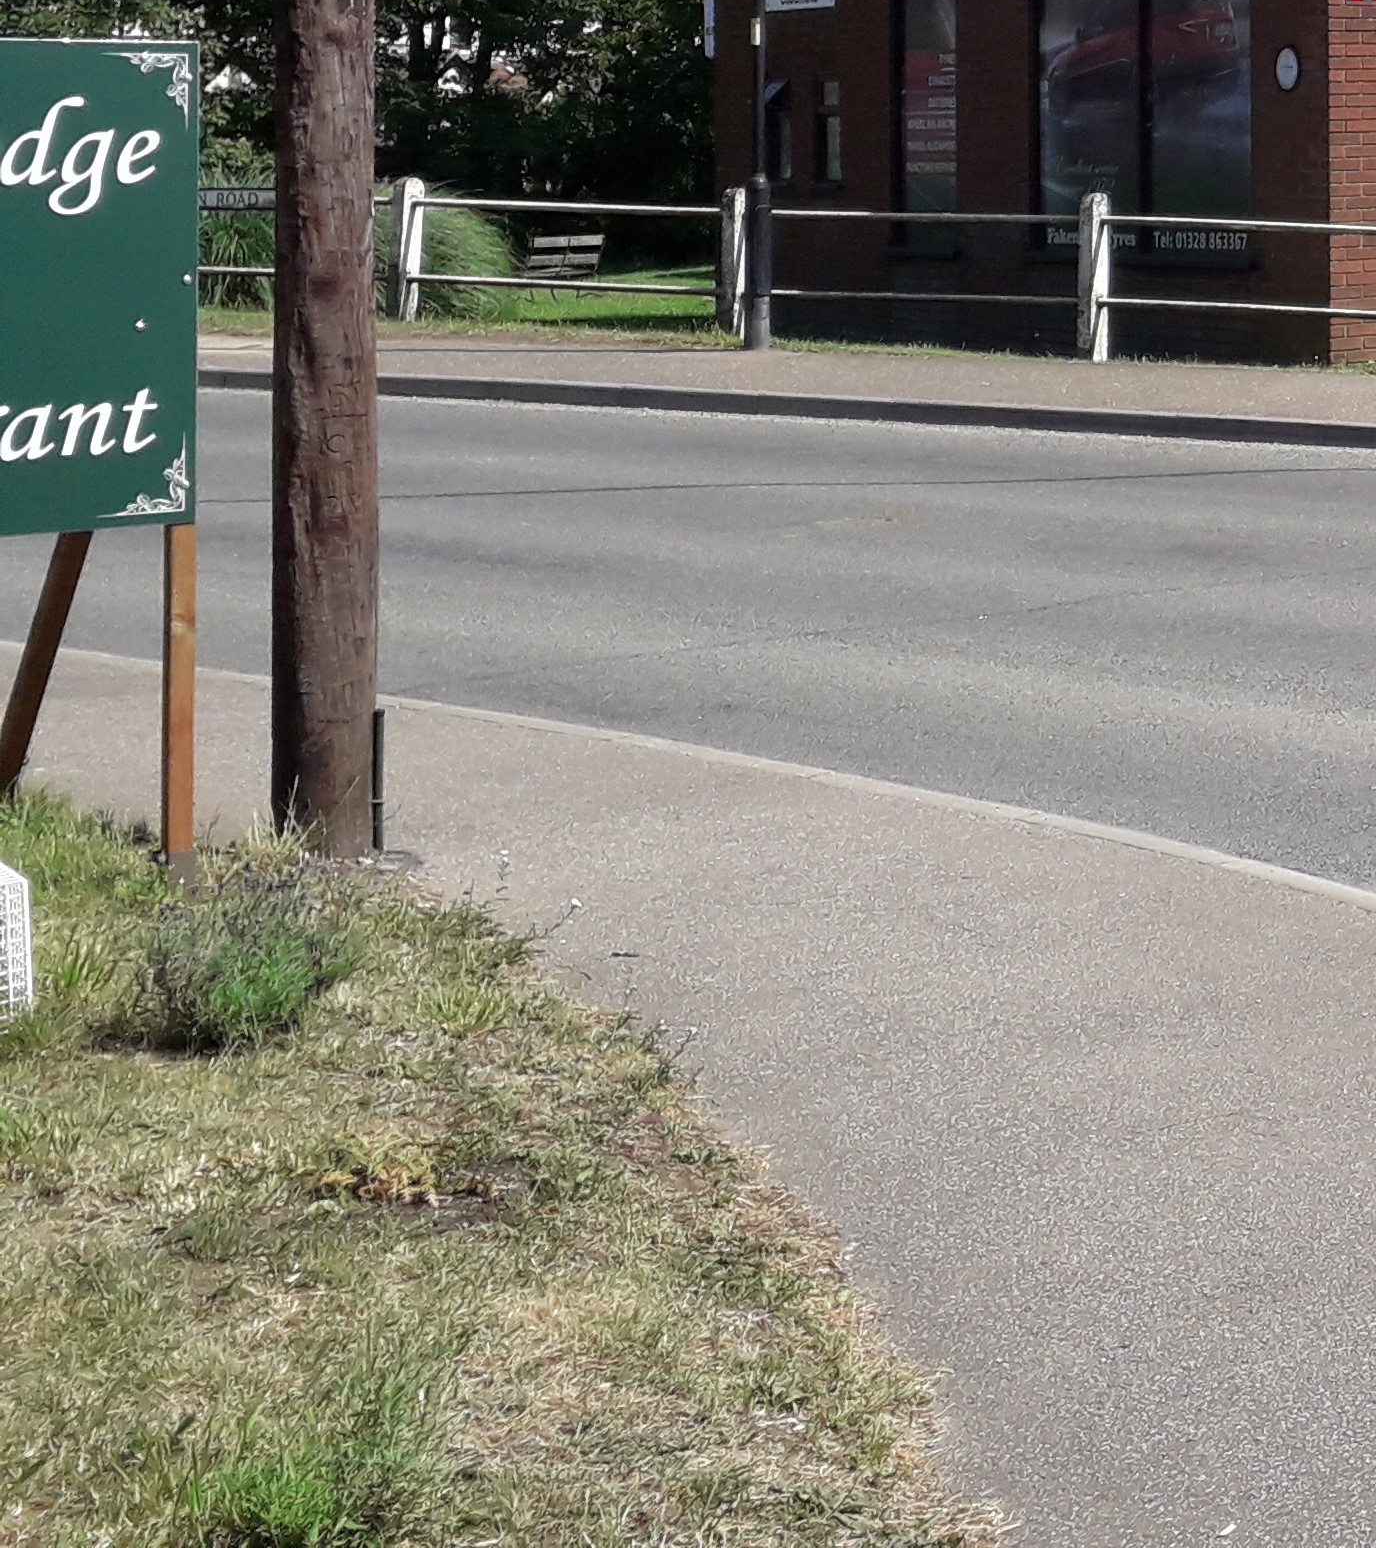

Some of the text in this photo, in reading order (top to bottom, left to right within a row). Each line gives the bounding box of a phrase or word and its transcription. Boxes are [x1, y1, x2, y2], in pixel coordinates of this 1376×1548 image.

[0, 94, 164, 217] dge
[216, 191, 259, 206] ROAD
[1111, 232, 1136, 250] yres
[1154, 231, 1173, 249] Tel:
[1175, 232, 1207, 250] 01328
[1208, 232, 1248, 250] 863367
[0, 387, 160, 463] ant
